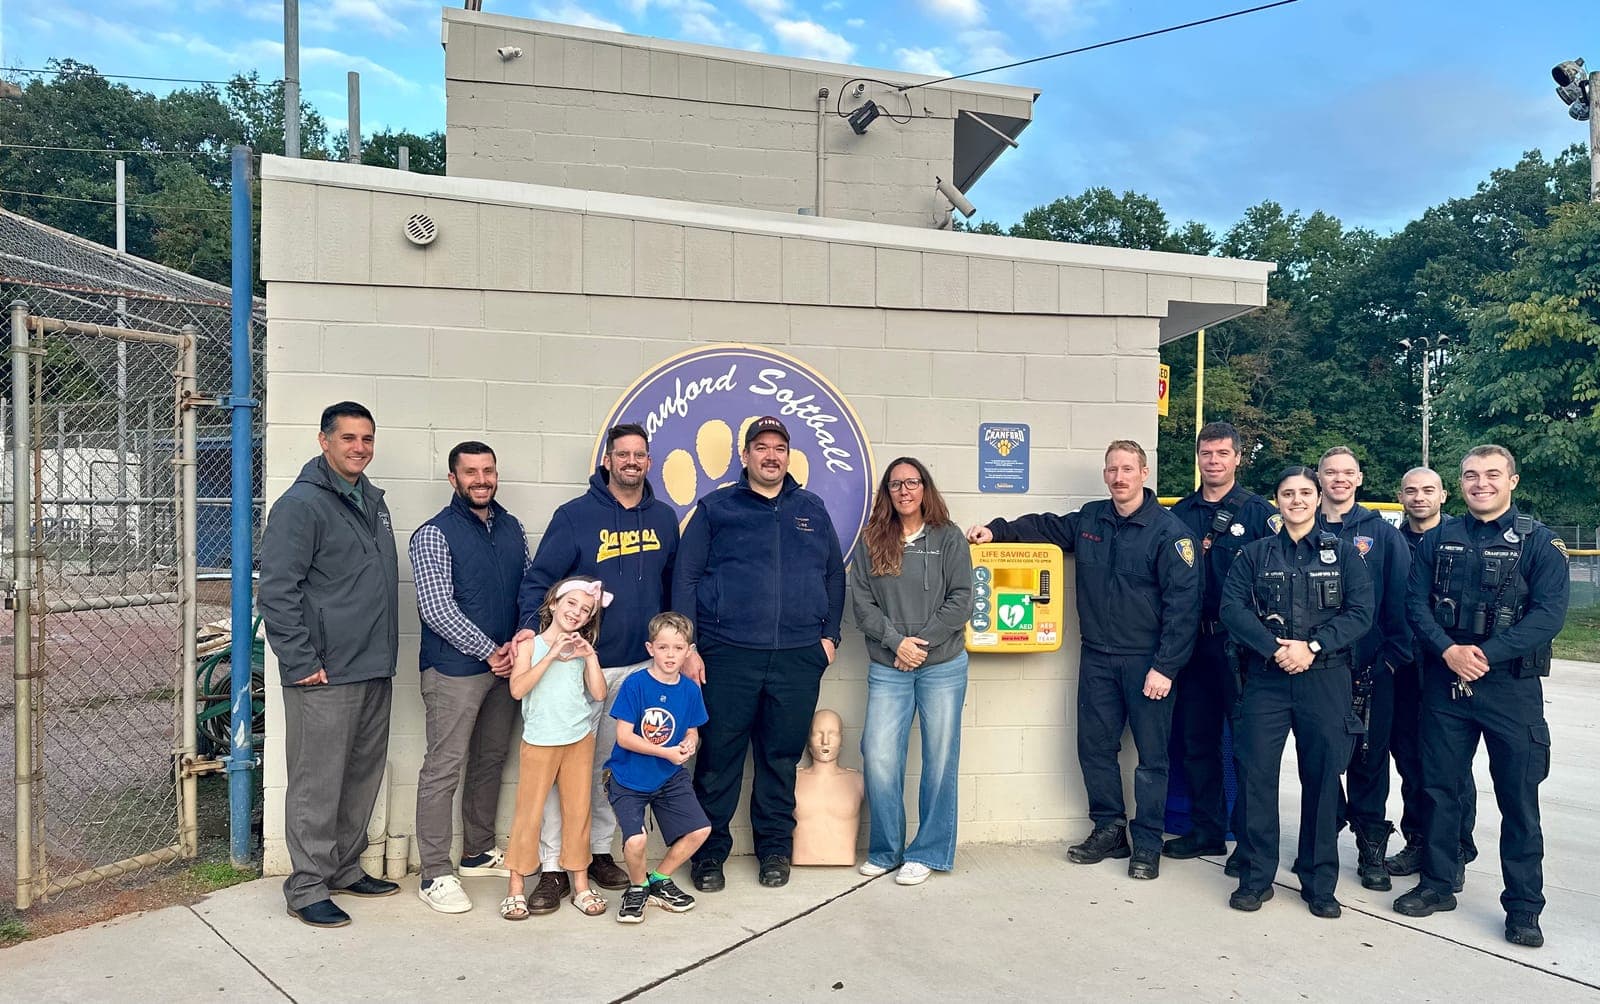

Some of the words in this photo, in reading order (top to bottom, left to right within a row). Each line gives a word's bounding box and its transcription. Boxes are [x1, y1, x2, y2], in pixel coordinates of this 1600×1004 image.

[1160, 368, 1168, 379] ED
[646, 364, 737, 443] anford
[748, 368, 854, 473] Softball
[758, 419, 781, 427] FIRE
[985, 429, 1025, 442] CRANFORD
[1000, 551, 1031, 559] SAVING
[1032, 551, 1049, 559] AED
